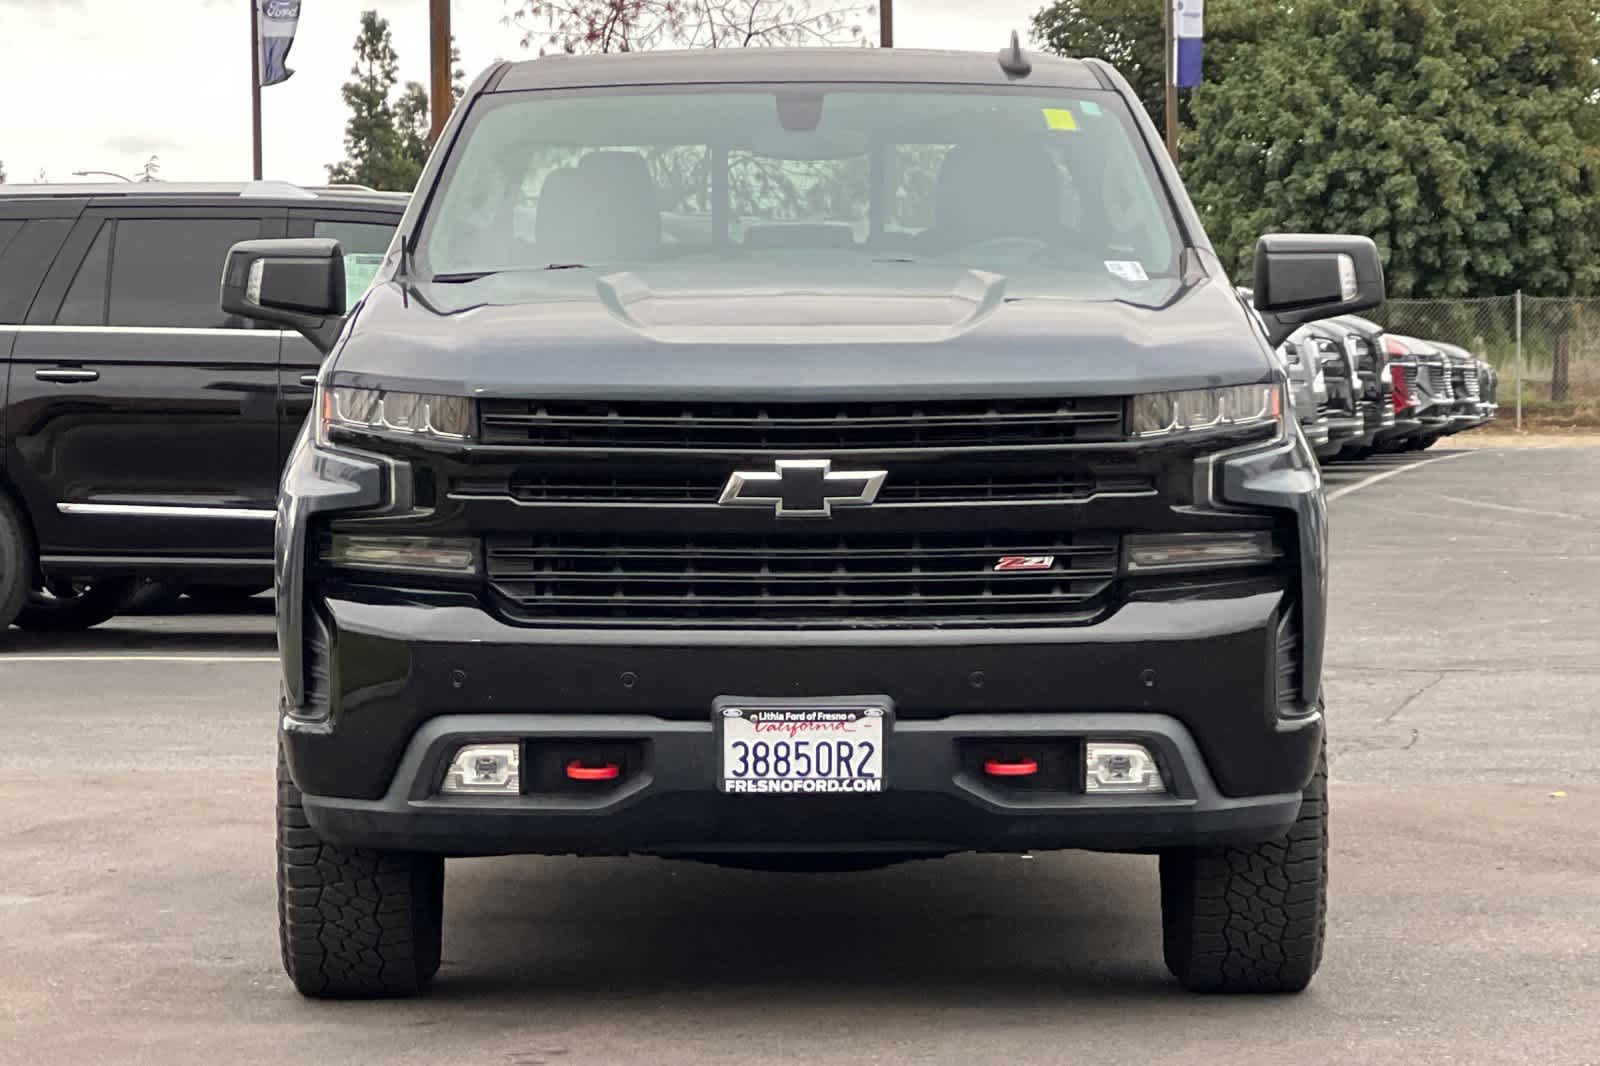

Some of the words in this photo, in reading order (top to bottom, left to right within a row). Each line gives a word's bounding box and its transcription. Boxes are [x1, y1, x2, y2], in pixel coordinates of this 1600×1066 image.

[266, 1, 299, 17] Ford
[758, 711, 785, 721] Lithia
[786, 711, 804, 721] Ford
[806, 712, 816, 721] of
[818, 712, 847, 721] Fresno
[755, 721, 856, 738] California
[732, 741, 875, 777] 38850R2
[725, 779, 881, 793] FRESNOFORD.COM
